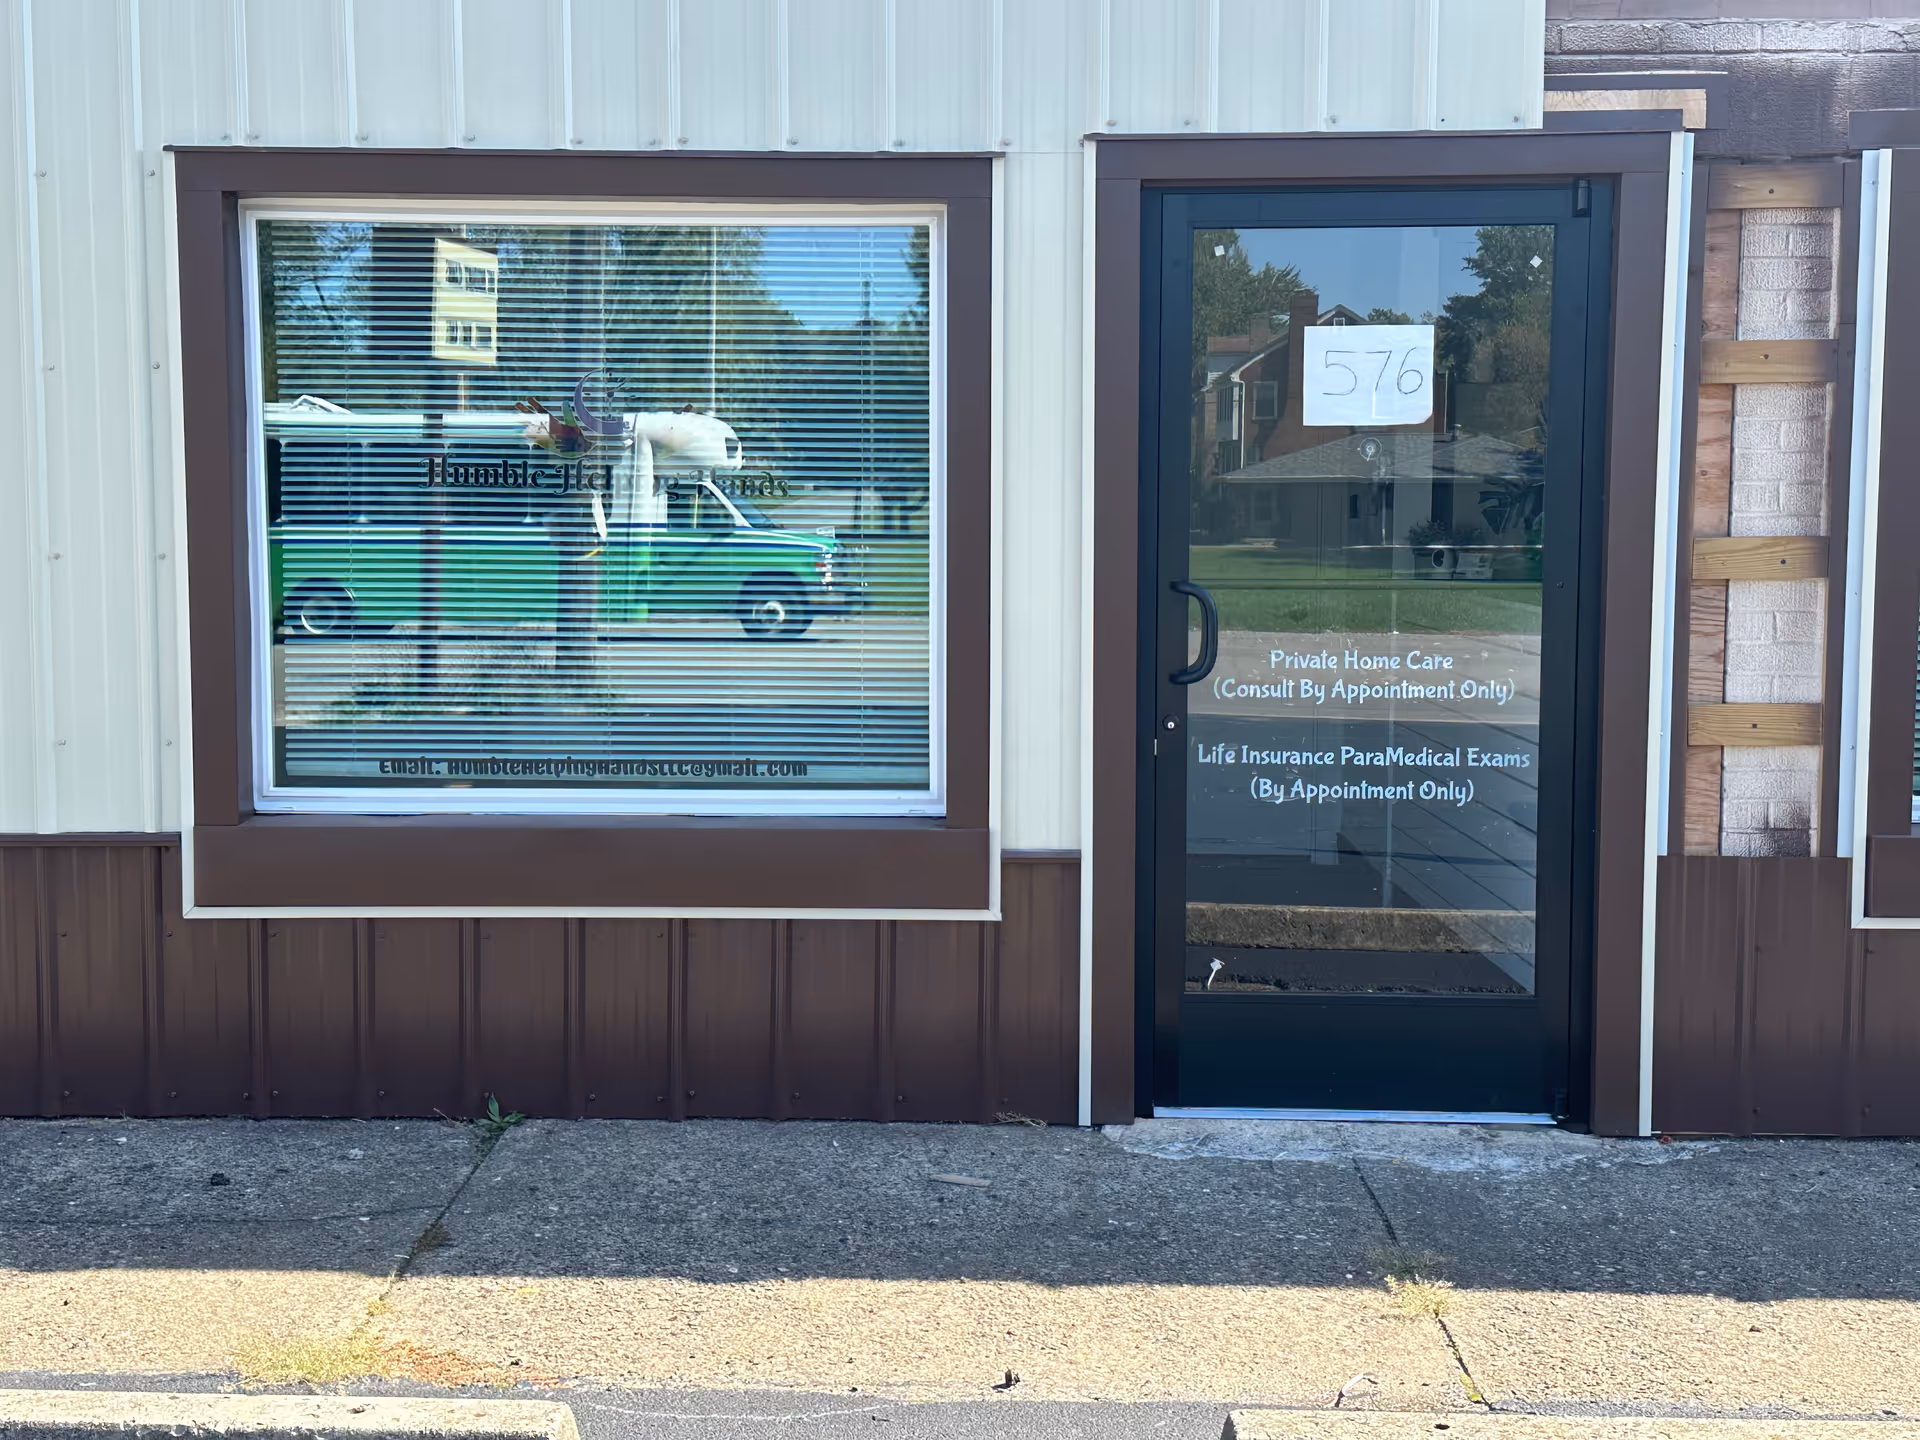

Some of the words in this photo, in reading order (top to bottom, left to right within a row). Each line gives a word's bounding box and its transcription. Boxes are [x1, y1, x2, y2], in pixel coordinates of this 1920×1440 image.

[1322, 346, 1424, 396] 576
[418, 452, 546, 489] Humble
[689, 465, 789, 498] Hands
[1270, 649, 1338, 670] Private
[1344, 650, 1401, 670] Home
[1406, 650, 1454, 670] Care
[1213, 677, 1294, 700] (Consult
[1299, 678, 1325, 705] By
[1331, 678, 1455, 704] Appointment
[1461, 678, 1515, 705] Only)
[378, 756, 441, 776] Email:
[1197, 743, 1236, 765] Life
[1241, 745, 1334, 766] Insurance
[1340, 746, 1460, 767] ParaMedical
[1467, 747, 1531, 768] Exams
[1250, 776, 1285, 805] (By
[1290, 778, 1414, 803] Appointment
[1419, 779, 1474, 807] Only)
